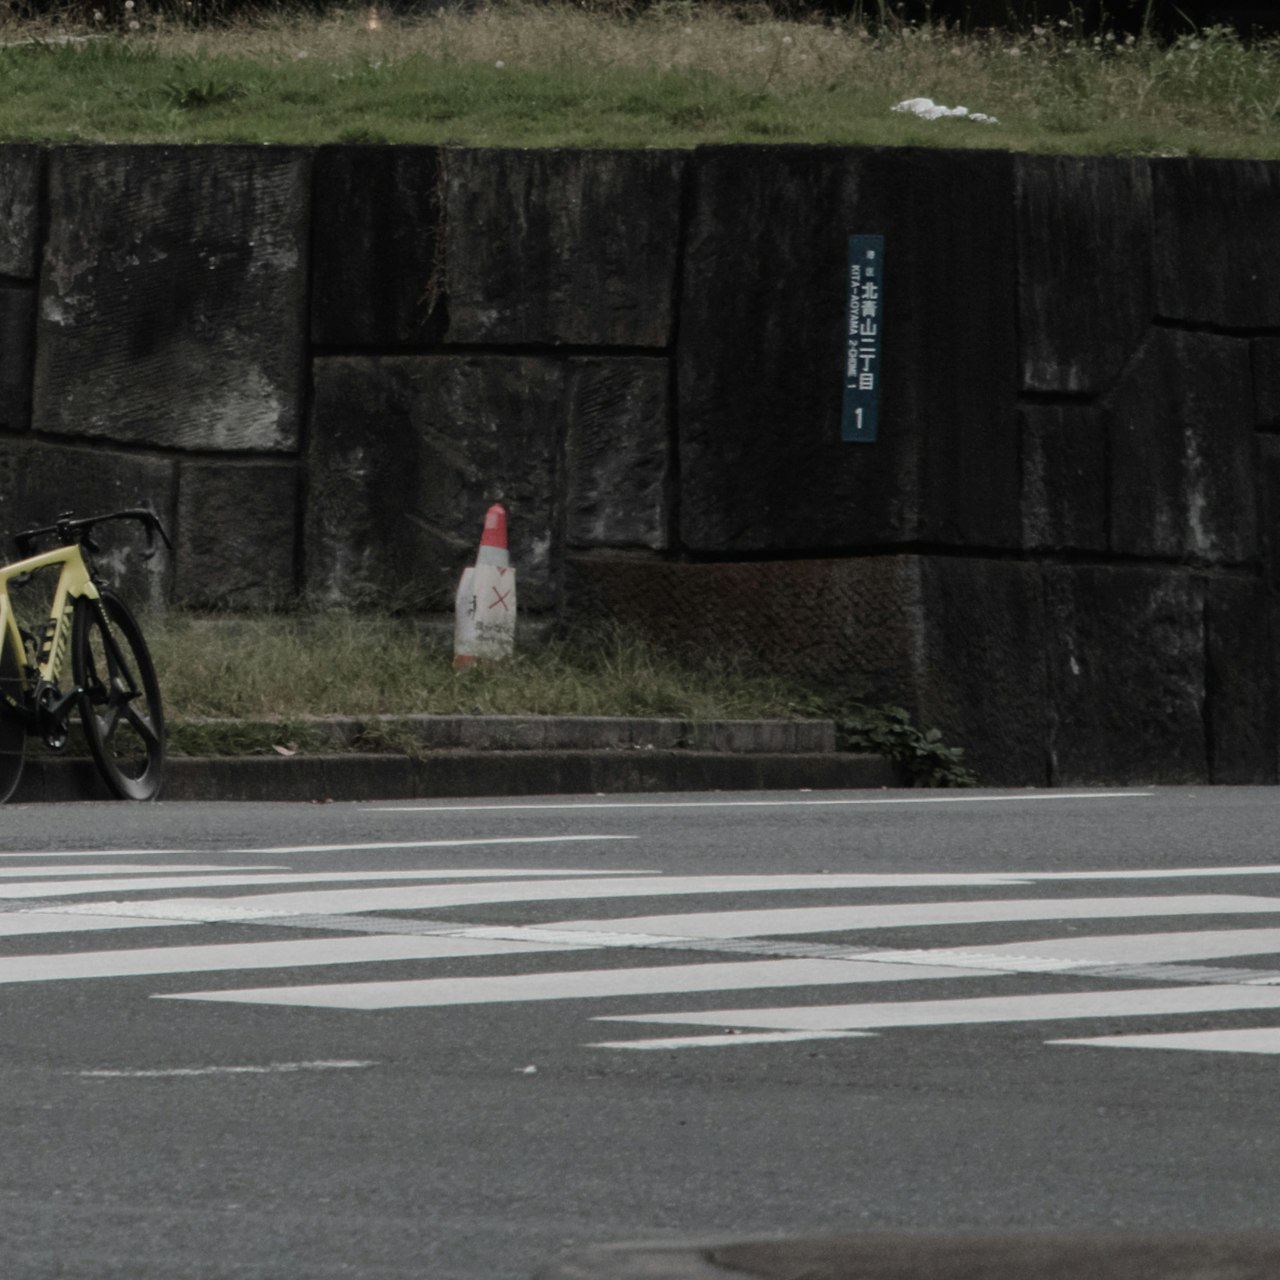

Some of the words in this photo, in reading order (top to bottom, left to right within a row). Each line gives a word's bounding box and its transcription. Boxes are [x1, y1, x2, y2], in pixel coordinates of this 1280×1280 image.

[849, 264, 861, 336] KITA-AOYAMA
[858, 281, 879, 391] 北青山二丁目
[854, 407, 864, 429] 1
